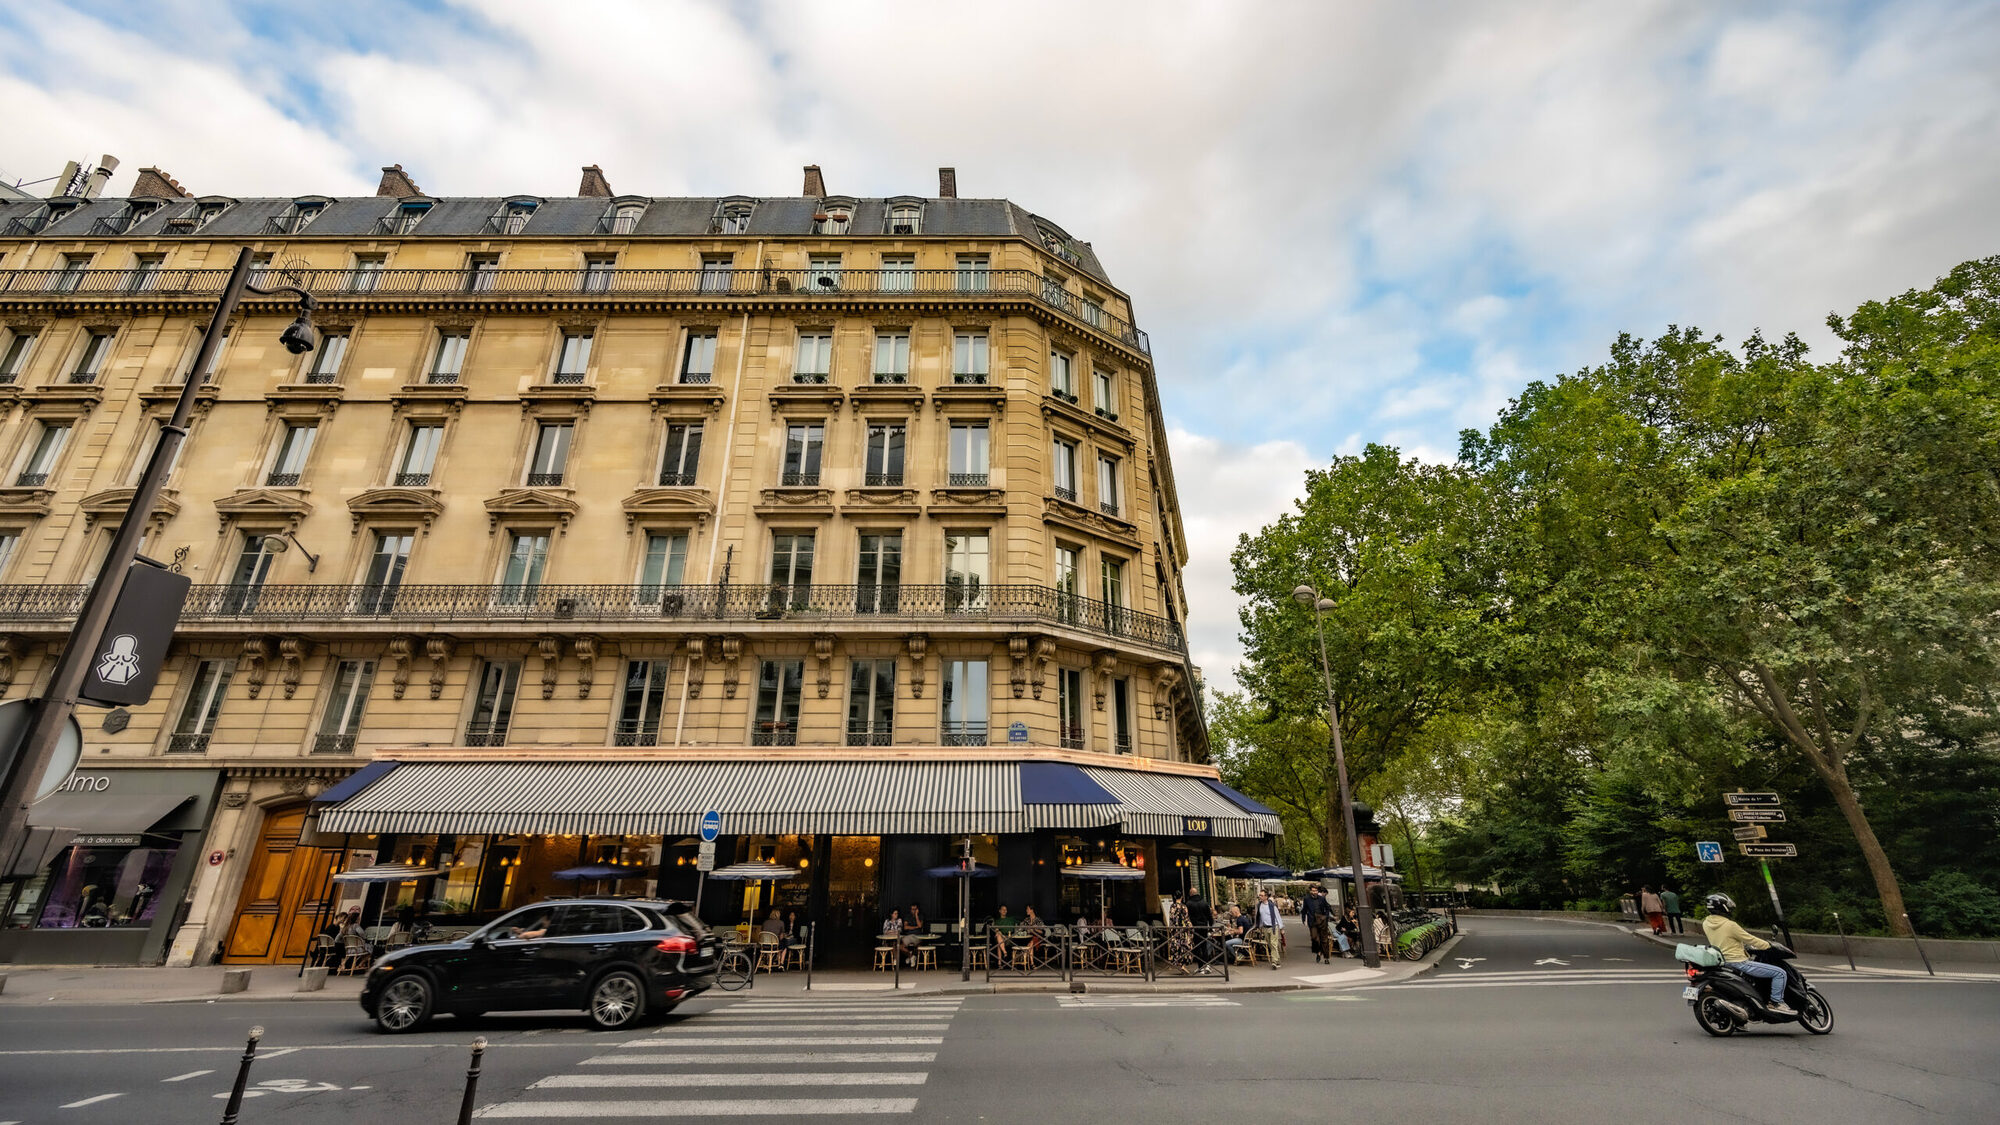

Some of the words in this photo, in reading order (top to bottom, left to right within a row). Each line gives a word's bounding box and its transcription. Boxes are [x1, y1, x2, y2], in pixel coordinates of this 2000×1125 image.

[57, 772, 110, 791] lmo
[1187, 820, 1207, 831] LOUP
[96, 836, 112, 844] deux
